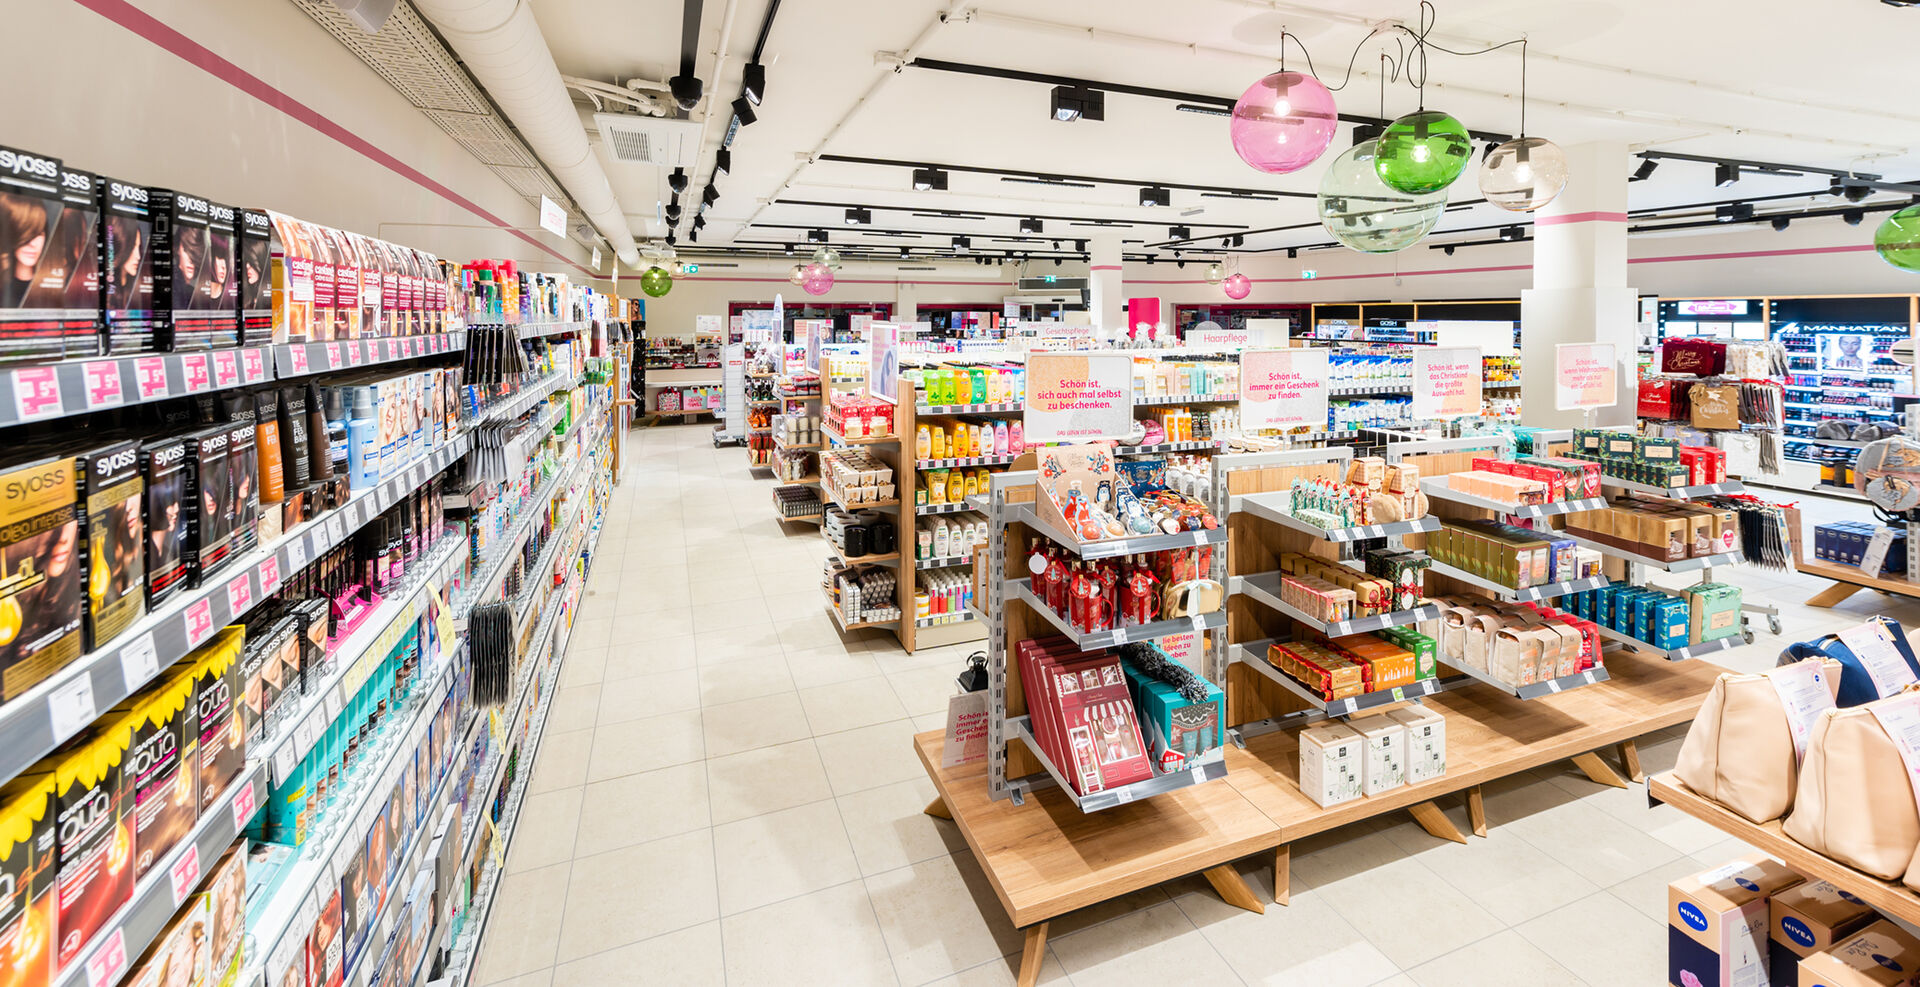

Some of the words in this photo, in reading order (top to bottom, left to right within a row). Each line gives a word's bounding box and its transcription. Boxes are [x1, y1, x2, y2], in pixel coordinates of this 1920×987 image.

[110, 182, 149, 203] syoss
[177, 195, 208, 213] syoss
[245, 212, 269, 226] syoss
[1803, 325, 1907, 333] MANHATTAN
[1203, 332, 1248, 345] Haarpflege
[1427, 363, 1445, 372] Schön
[1268, 372, 1290, 381] Schön
[1440, 371, 1468, 380] Christkind
[1059, 379, 1087, 389] Schön
[1088, 379, 1102, 389] ist,
[1249, 383, 1273, 391] immer
[1274, 382, 1286, 390] ein
[1286, 380, 1320, 390] Geschenk
[1444, 379, 1463, 389] größte
[1037, 390, 1055, 400] sich
[1056, 390, 1077, 399] auch
[1079, 389, 1096, 399] mal
[1096, 389, 1122, 398] selbst
[1278, 391, 1303, 399] finden.
[1432, 389, 1455, 397] Auswahl
[1059, 400, 1112, 410] beschenken.
[231, 425, 255, 443] syoss
[202, 434, 228, 454] syoss
[154, 444, 186, 467] syoss
[96, 449, 137, 477] syoss
[6, 469, 66, 502] syoss
[280, 619, 299, 641] syoss
[1171, 633, 1194, 642] besten
[261, 637, 281, 659] syoss
[199, 677, 224, 701] GARNIER
[957, 711, 981, 721] Schön
[956, 719, 981, 729] immer
[134, 725, 169, 757] GARNIER
[57, 784, 102, 824] GARNIER
[1680, 906, 1706, 927] NIVEA
[1783, 921, 1813, 943] NIVEA
